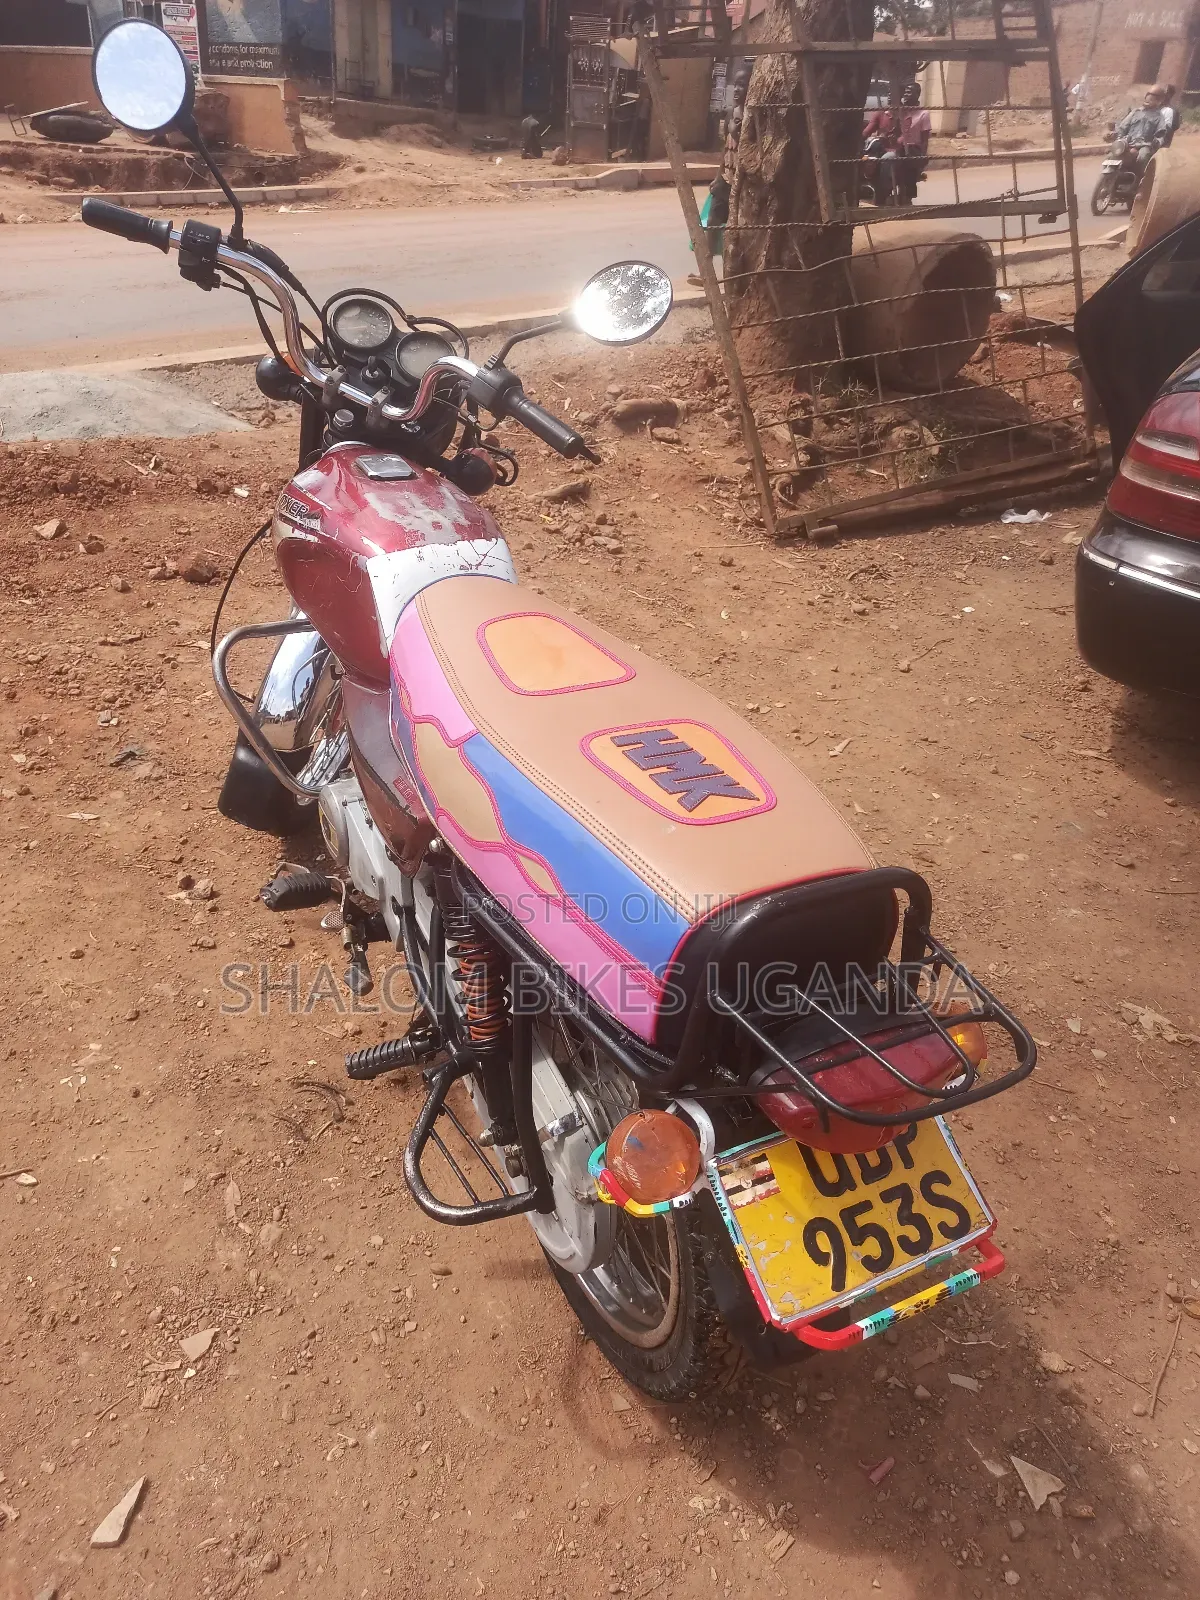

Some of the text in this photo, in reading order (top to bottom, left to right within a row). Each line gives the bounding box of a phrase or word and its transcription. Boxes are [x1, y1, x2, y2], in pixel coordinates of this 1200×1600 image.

[239, 44, 248, 54] for
[610, 728, 760, 812] HMK
[803, 1169, 971, 1292] 953S
